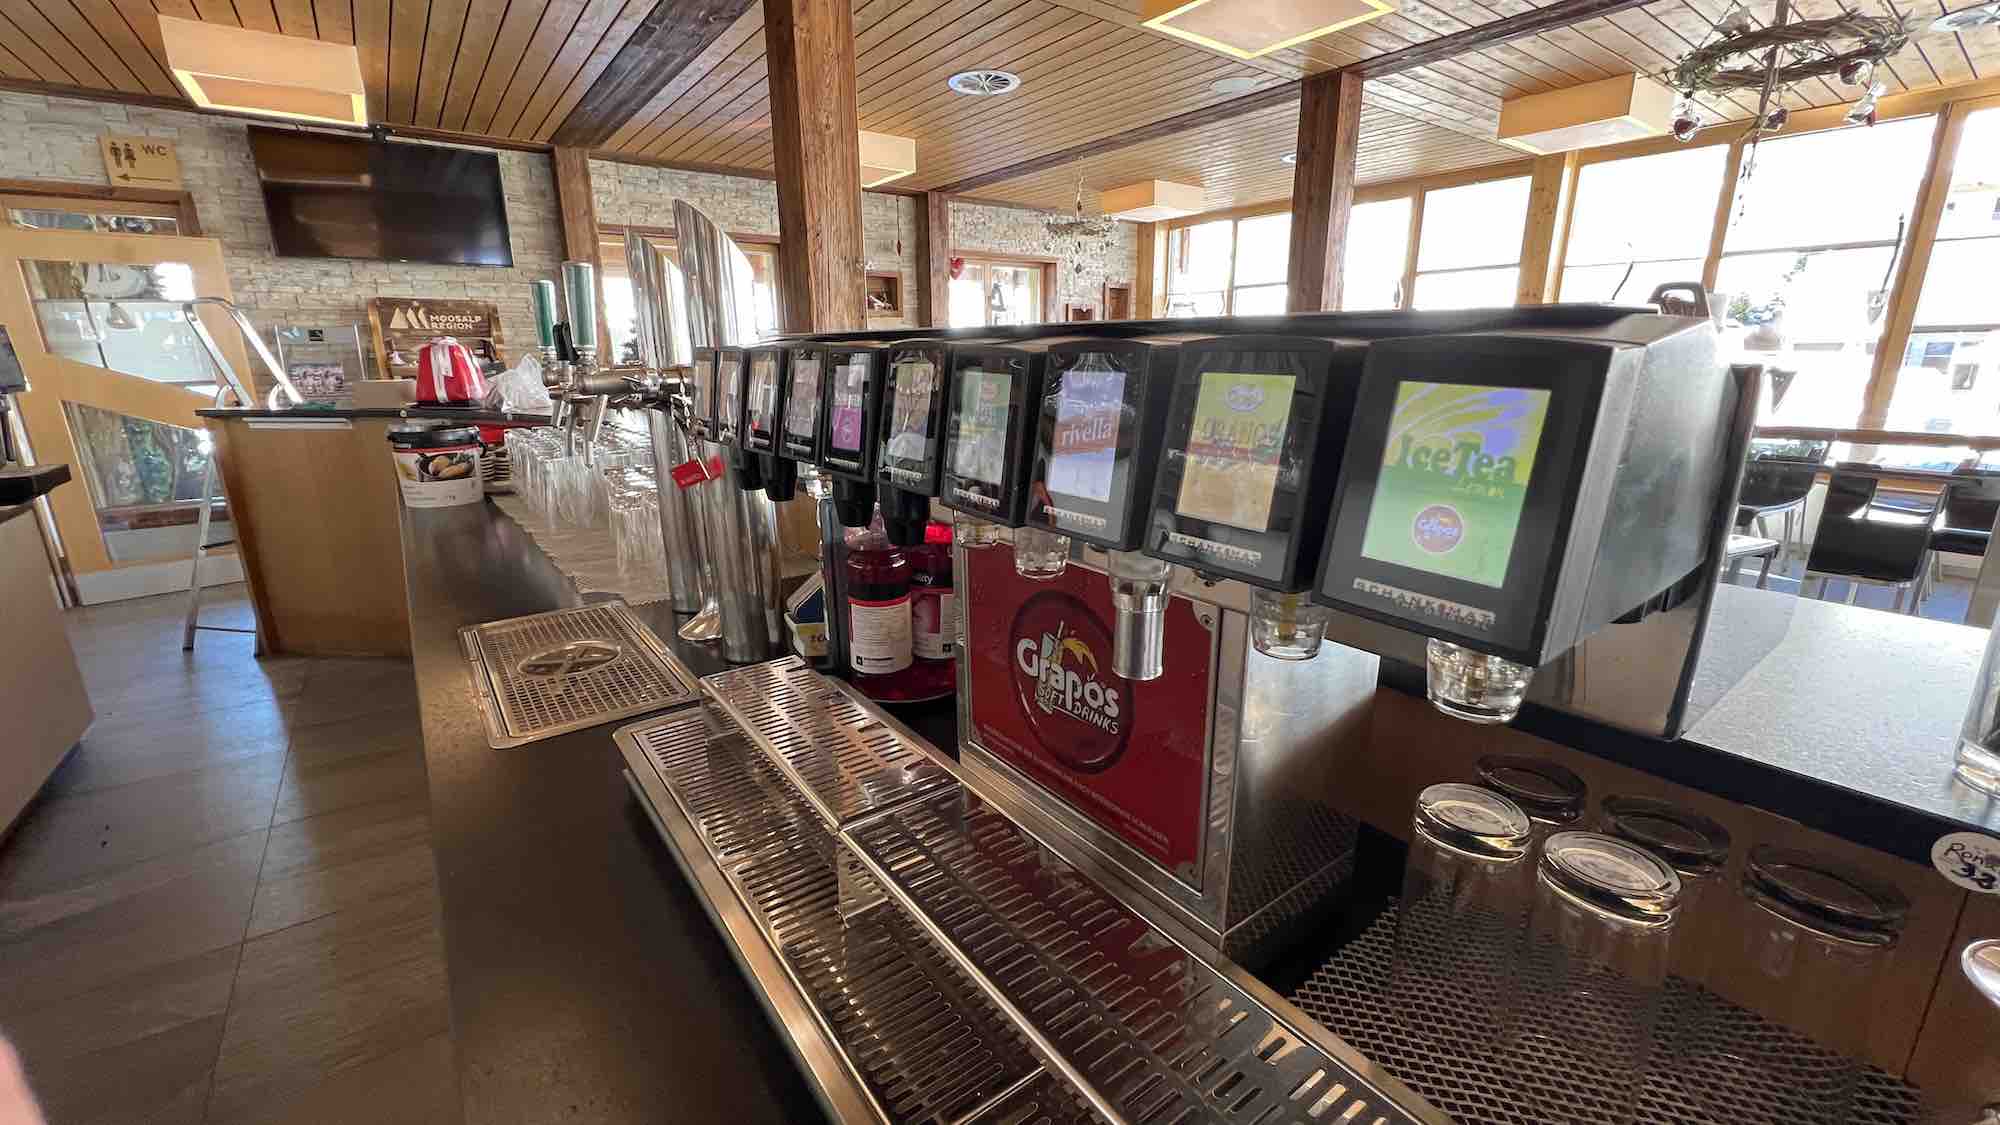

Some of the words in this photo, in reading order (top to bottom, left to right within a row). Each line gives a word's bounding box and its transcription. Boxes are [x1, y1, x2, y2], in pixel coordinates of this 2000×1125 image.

[142, 143, 168, 157] WC
[430, 314, 482, 323] MOOSALP
[431, 322, 472, 330] REGION
[1061, 417, 1113, 447] rivella
[1073, 701, 1120, 735] DRINKS
